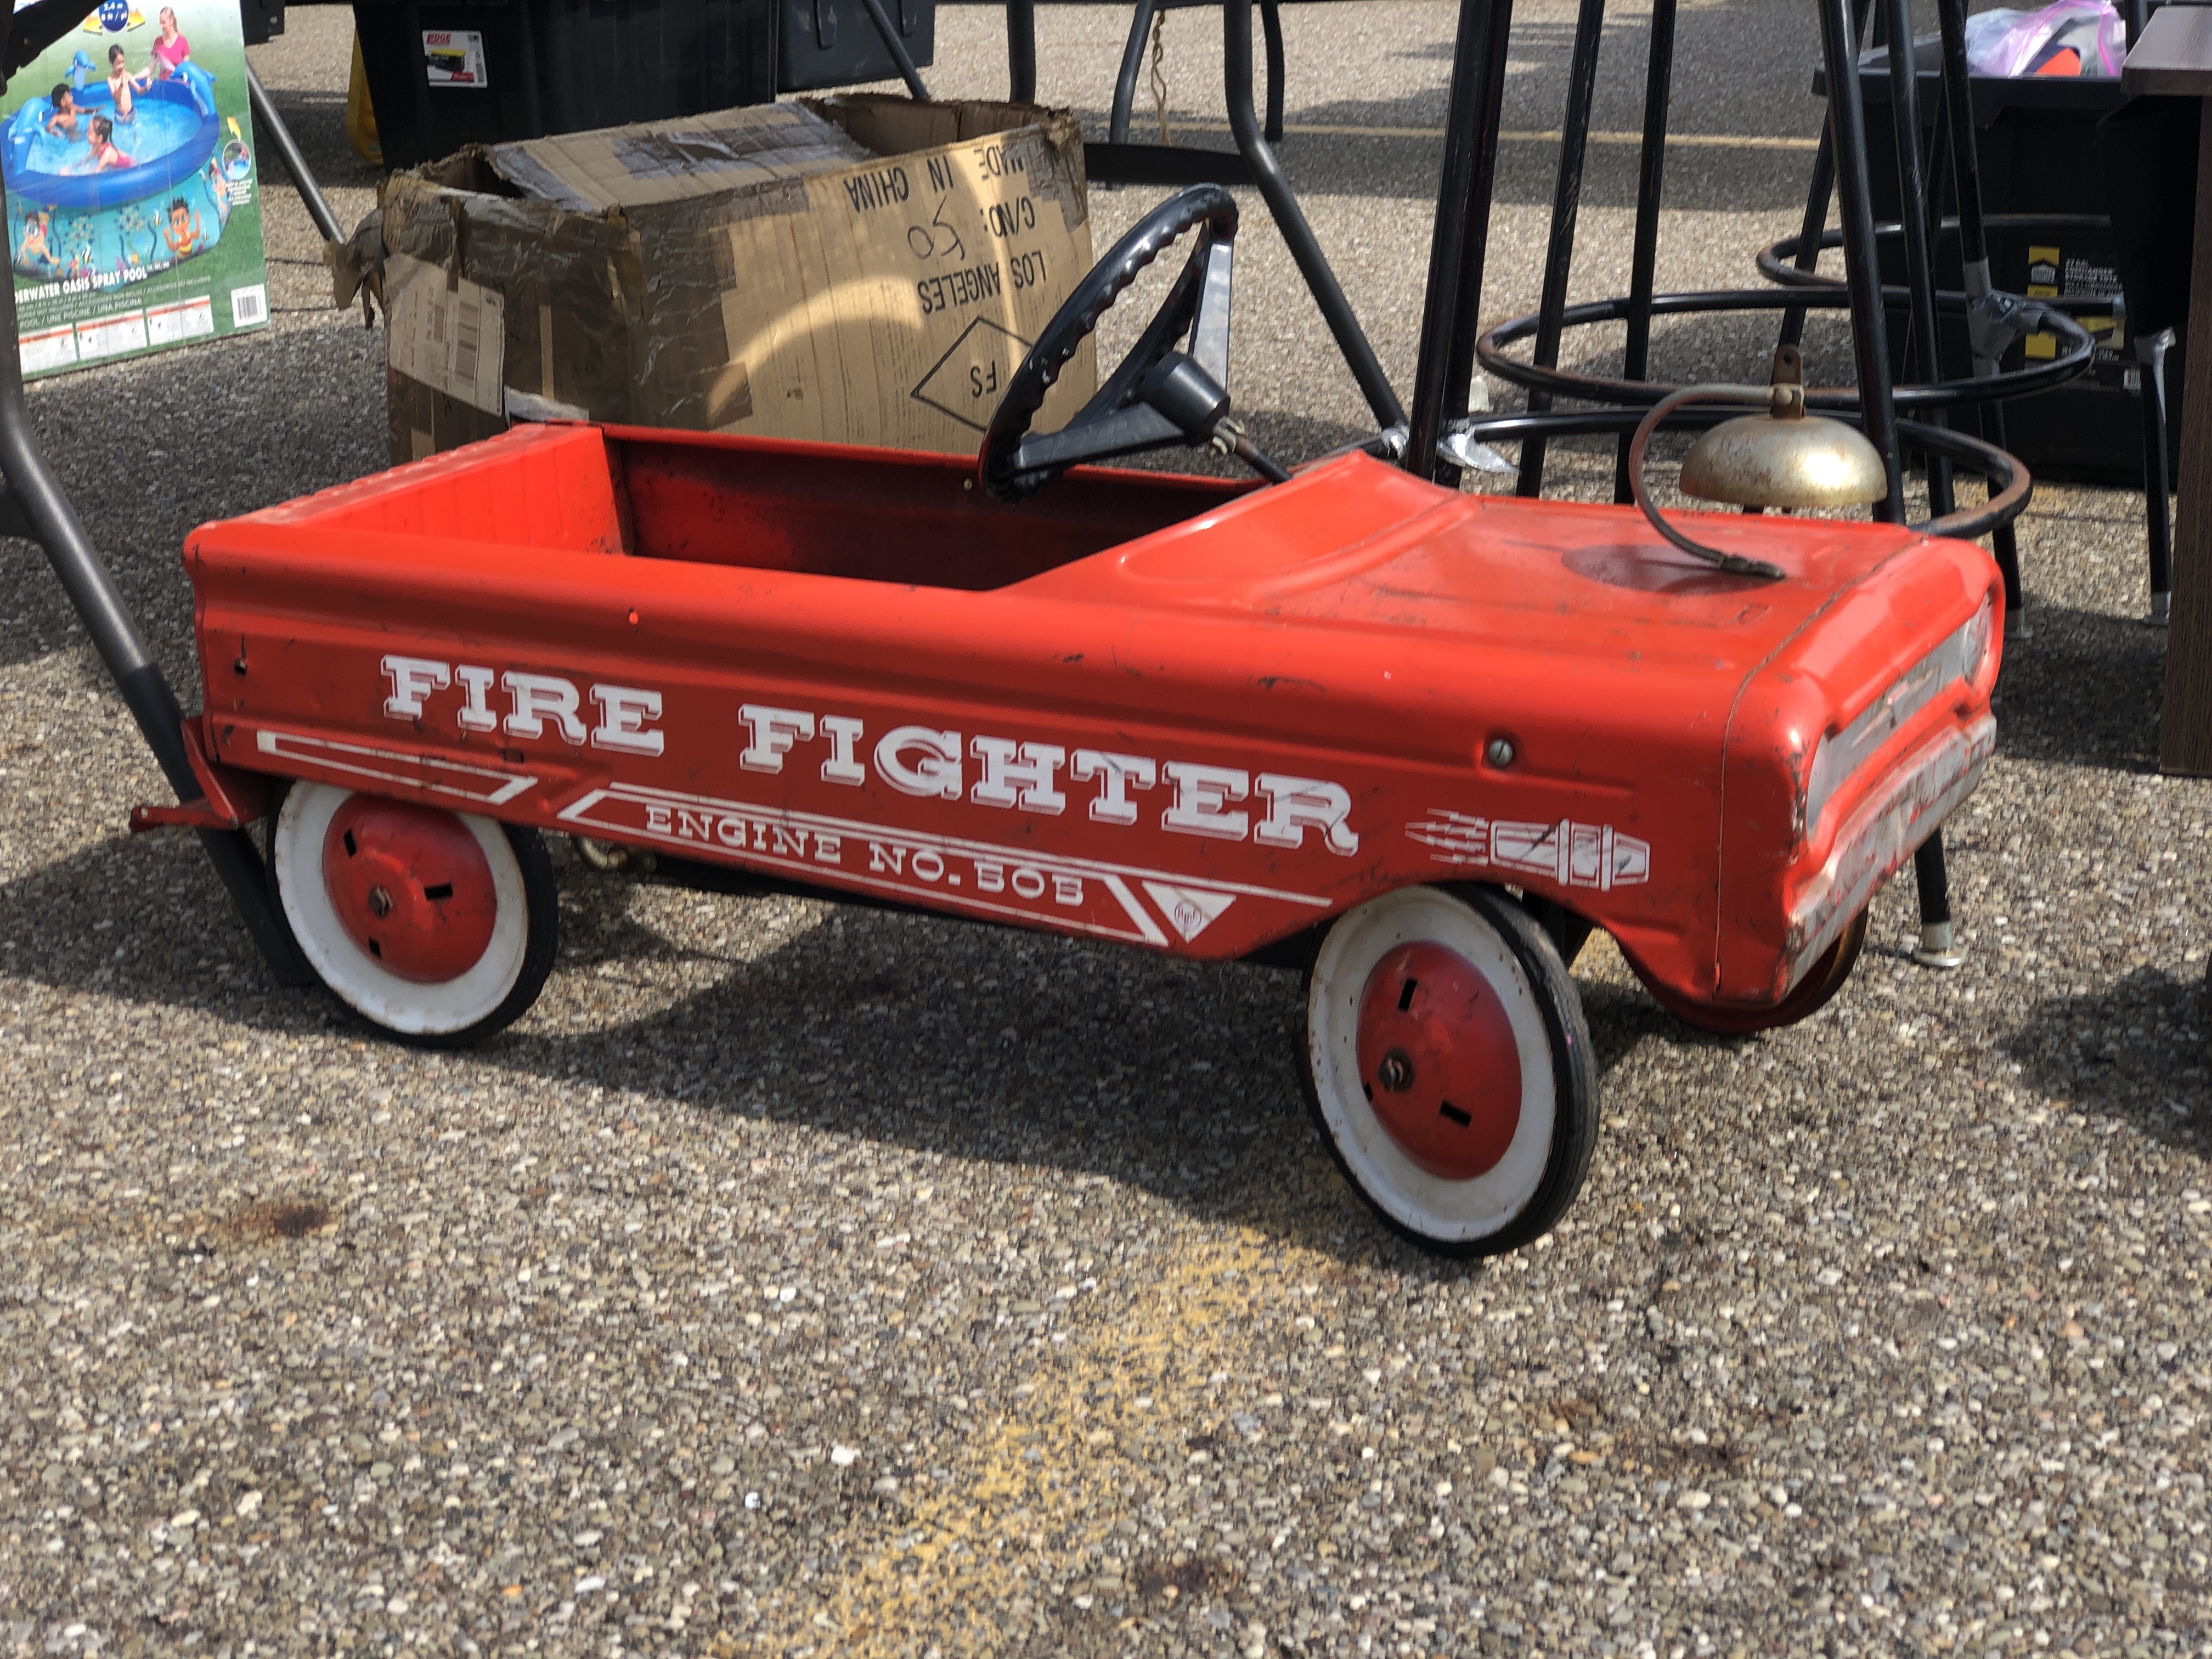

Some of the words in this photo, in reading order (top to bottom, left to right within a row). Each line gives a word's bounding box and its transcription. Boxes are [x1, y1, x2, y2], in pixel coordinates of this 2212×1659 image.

[843, 167, 910, 213] CHINA
[928, 156, 954, 194] IN
[63, 276, 90, 295] OASIS
[92, 270, 121, 289] SPRAY
[123, 265, 148, 283] POOL
[918, 262, 1001, 314] ANGELES
[1012, 250, 1047, 290] LOS
[969, 360, 997, 398] FS
[380, 654, 664, 757] FIRE
[738, 703, 1359, 857] FIGHTER
[645, 803, 841, 864] ENGINE
